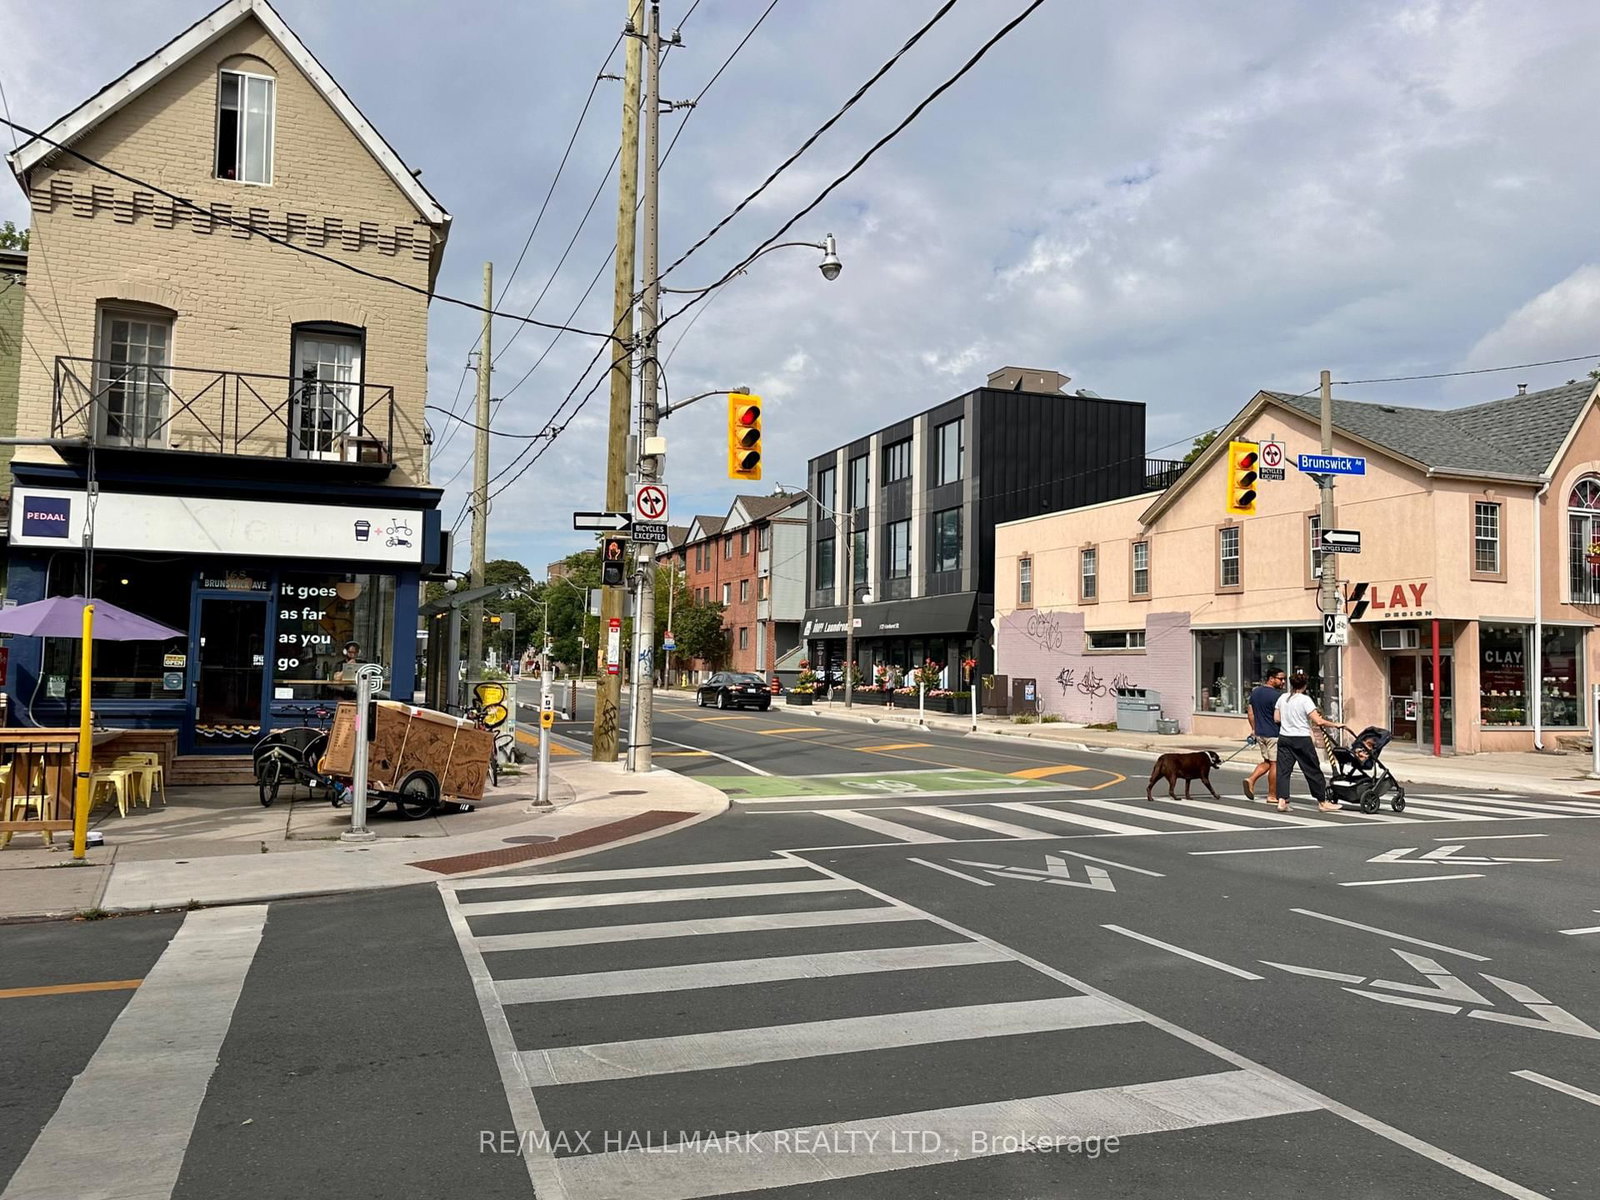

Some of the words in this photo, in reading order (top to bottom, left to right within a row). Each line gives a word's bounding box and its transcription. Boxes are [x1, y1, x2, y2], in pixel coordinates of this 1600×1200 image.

[1302, 456, 1352, 470] Brunswick
[27, 512, 66, 521] PEDAAL
[204, 579, 249, 589] BRUNSWICK
[252, 581, 267, 589] AVE
[281, 583, 294, 595] it
[298, 586, 337, 599] goes
[1371, 583, 1428, 609] LAY
[280, 609, 298, 619] as
[302, 607, 326, 620] far
[1385, 610, 1433, 618] DESIGN
[279, 634, 297, 643] as
[301, 635, 331, 647] you
[1485, 650, 1522, 663] CLAY
[277, 658, 299, 670] go
